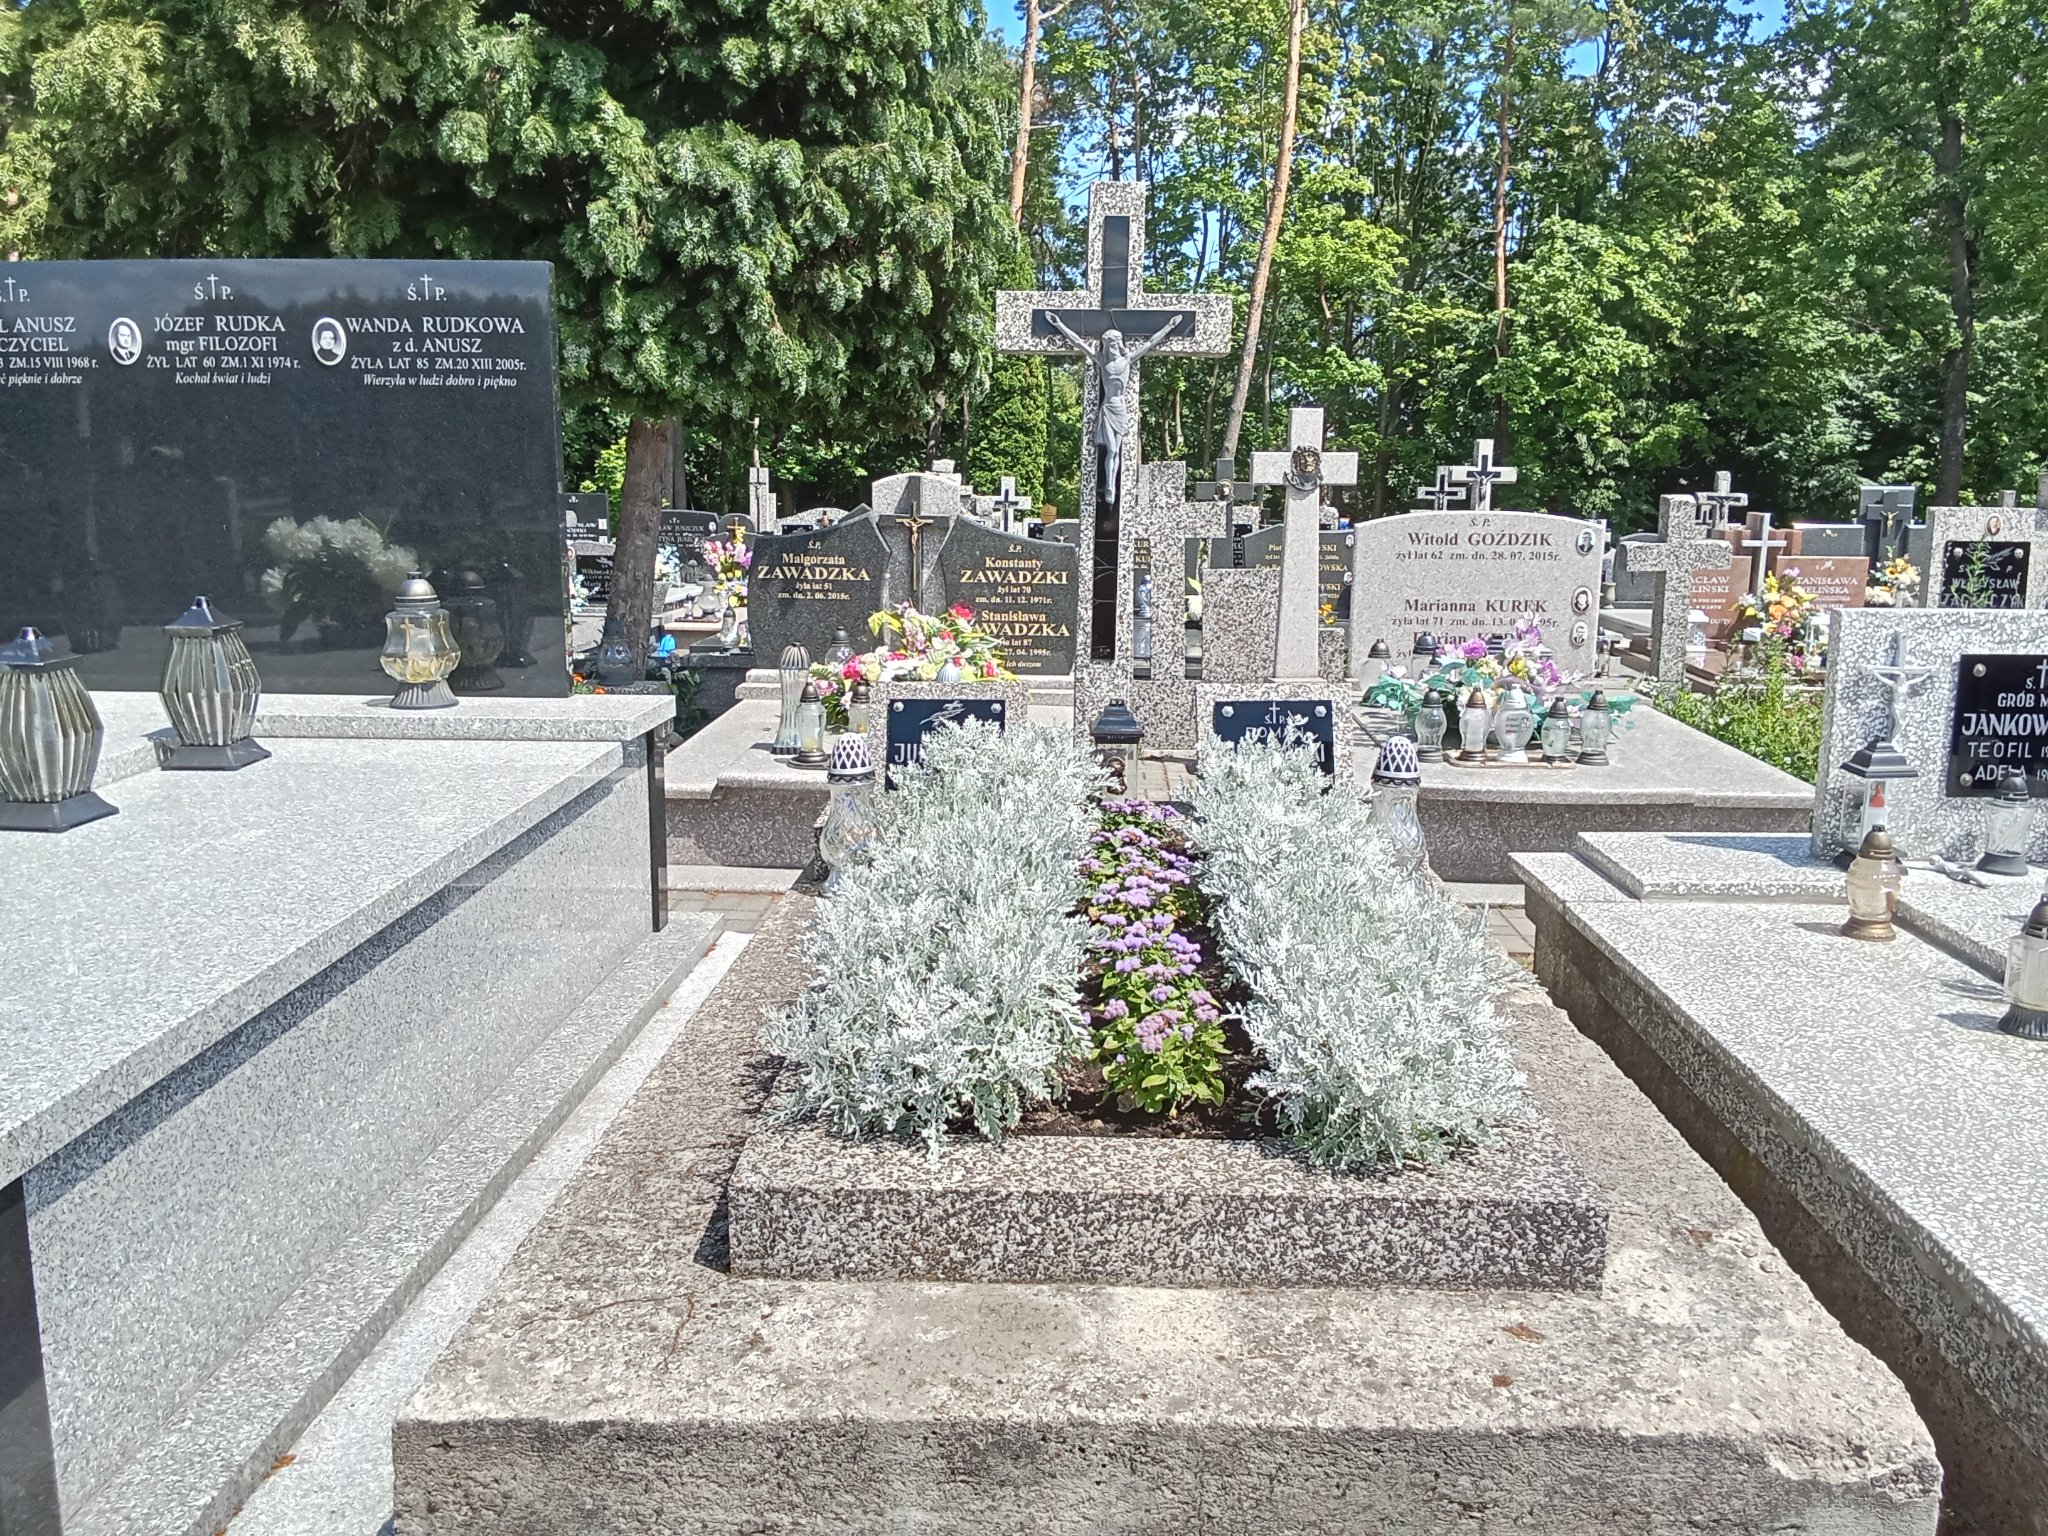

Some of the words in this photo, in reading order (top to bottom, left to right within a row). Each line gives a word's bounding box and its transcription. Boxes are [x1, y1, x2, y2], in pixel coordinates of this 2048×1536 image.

[13, 316, 76, 333] ANUSZ
[154, 312, 205, 332] JÓZEF
[214, 315, 286, 332] RUDKA
[345, 317, 413, 333] WANDA
[422, 317, 526, 334] RUDKOWA
[166, 340, 196, 355] mgr
[199, 336, 277, 351] FILOZOFI
[392, 341, 402, 353] z
[404, 338, 418, 353] d.
[422, 338, 483, 353] ANUSZ
[43, 357, 63, 368] VIII
[66, 356, 90, 368] 1968
[175, 356, 198, 368] LAT
[203, 357, 216, 368] 60
[251, 357, 264, 368] XI
[268, 357, 291, 368] 1974
[388, 357, 412, 369] LAT
[416, 358, 429, 369] 85
[471, 359, 493, 370] XIII
[8, 372, 42, 387] pięknie
[50, 371, 83, 384] dobrze
[212, 372, 239, 384] świat
[247, 372, 272, 384] ludzi
[407, 376, 417, 386] w
[419, 374, 443, 386] ludzi
[445, 375, 475, 386] dobro
[483, 375, 517, 389] piękno
[1408, 532, 1459, 546] Witold
[1467, 530, 1553, 546] GOŹDZIK
[985, 557, 1044, 570] Konstanty
[1414, 551, 1428, 559] lat
[1431, 551, 1443, 559] 62
[1472, 552, 1488, 560] dn.
[1528, 552, 1561, 561] 2015r.
[757, 565, 871, 580] ZAWADZKA
[960, 569, 1069, 584] ZAWADZKI
[824, 582, 833, 590] 51
[1691, 584, 1730, 593] LIŃSKI
[1795, 577, 1858, 585] TANISŁAWA
[1404, 599, 1476, 612] Marianna
[1415, 617, 1430, 625] lat
[1433, 617, 1444, 625] 71
[1472, 617, 1488, 626] dn.
[973, 623, 1070, 637] AWADZKA
[1997, 690, 2035, 707] GRÓB
[1961, 713, 2048, 736] JANKOW
[1967, 742, 2032, 758] TEOFIL
